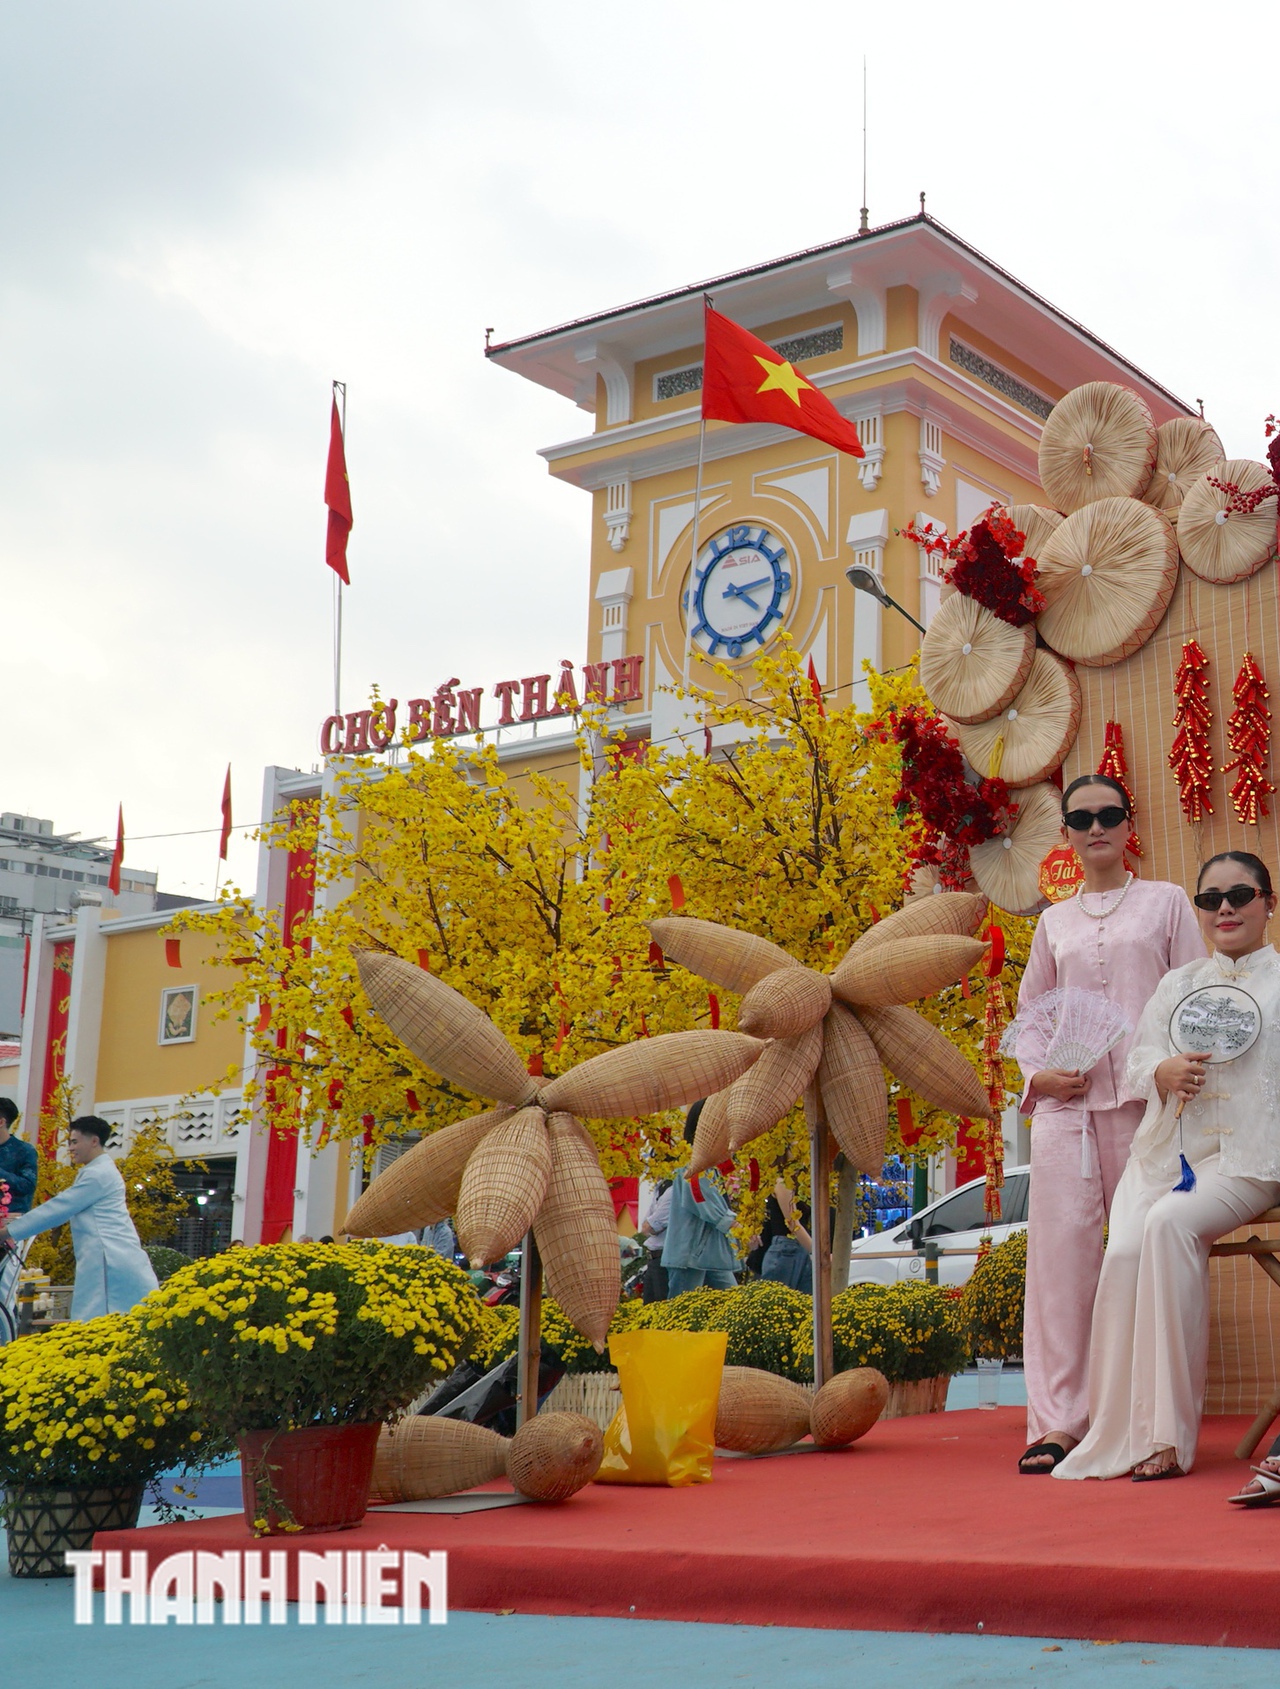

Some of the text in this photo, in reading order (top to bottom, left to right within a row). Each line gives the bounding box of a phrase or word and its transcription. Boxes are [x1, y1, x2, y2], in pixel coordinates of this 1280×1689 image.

[726, 525, 750, 549] 12
[776, 572, 791, 593] 3
[727, 638, 742, 658] 6
[320, 655, 645, 754] CHỢ BẾN THÀNH
[1051, 859, 1077, 882] Tài
